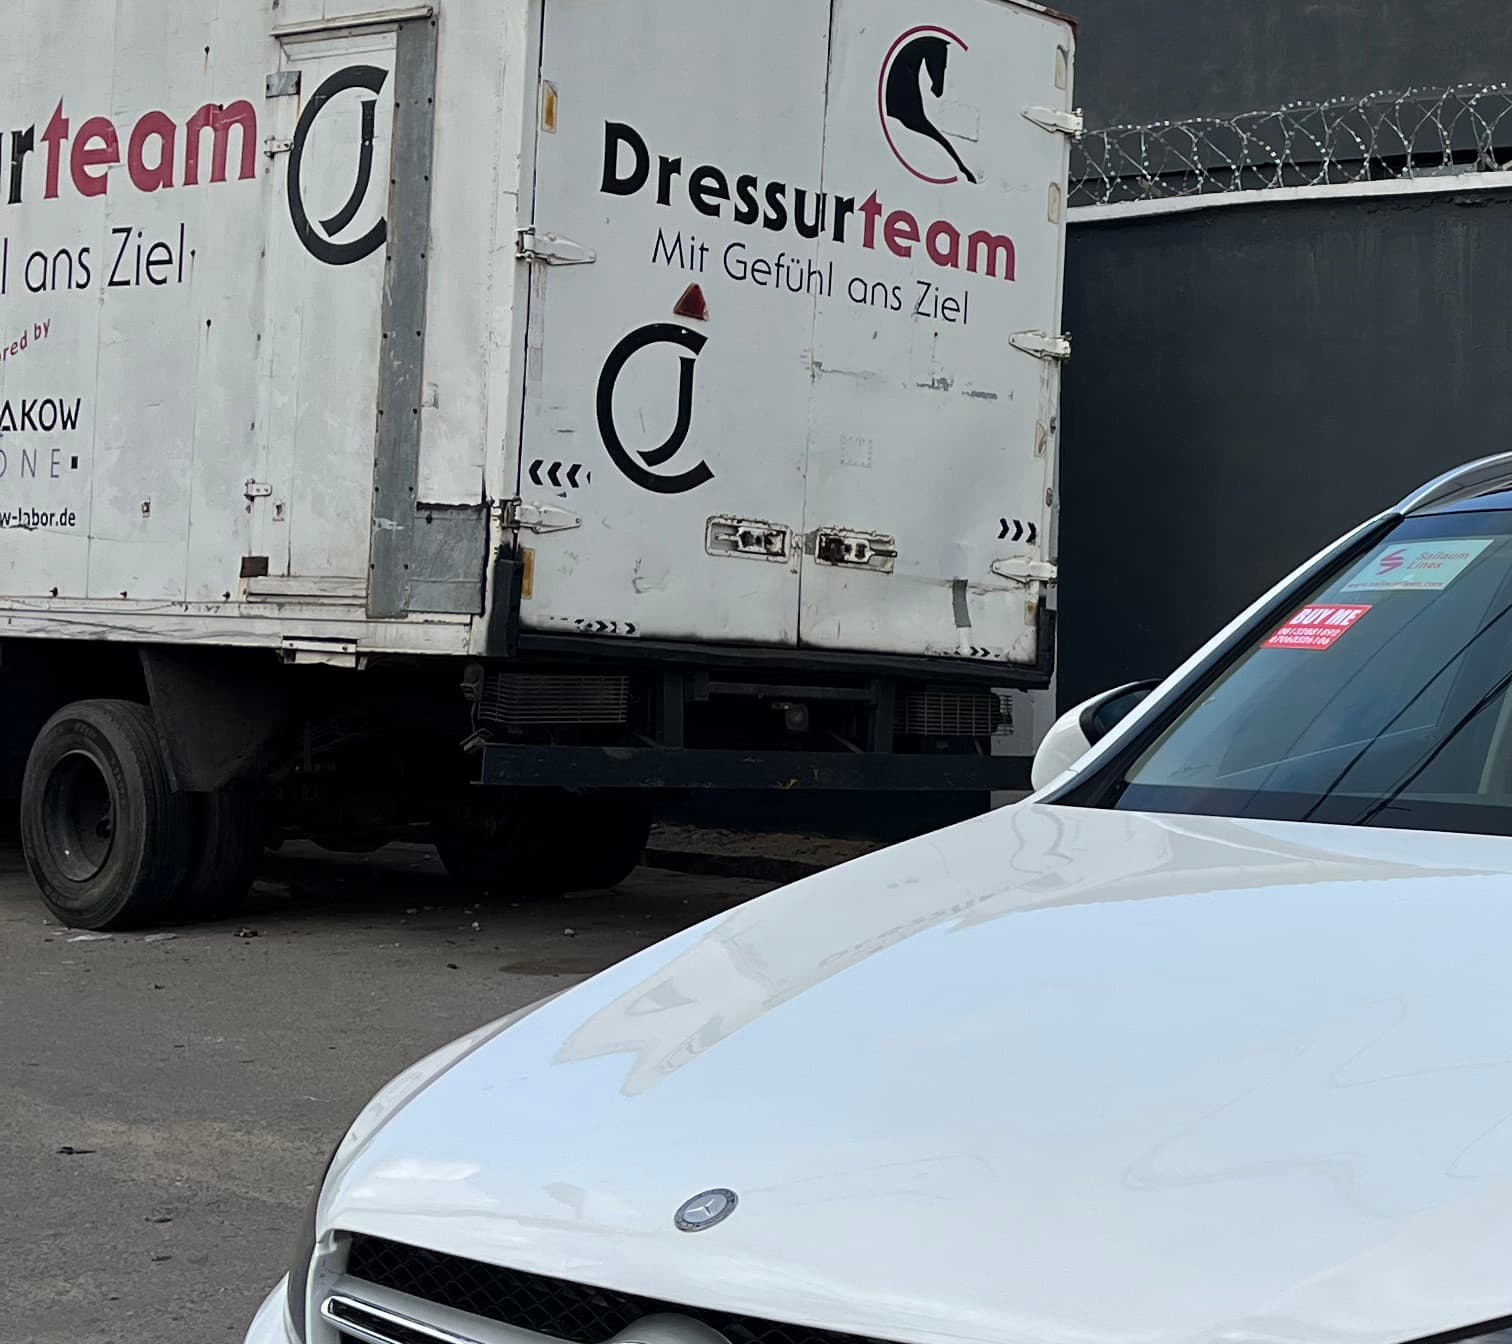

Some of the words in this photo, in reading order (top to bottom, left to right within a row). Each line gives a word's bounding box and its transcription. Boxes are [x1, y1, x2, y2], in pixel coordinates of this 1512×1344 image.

[600, 120, 1016, 283] Dressurteam
[25, 247, 91, 293] ans
[107, 222, 185, 287] Ziel
[652, 227, 709, 273] Mit
[723, 241, 833, 297] Gefühl
[847, 275, 901, 312] ans
[915, 279, 969, 325] Ziel
[34, 318, 51, 341] by
[1289, 608, 1337, 625] BUY
[1324, 608, 1363, 626] ME
